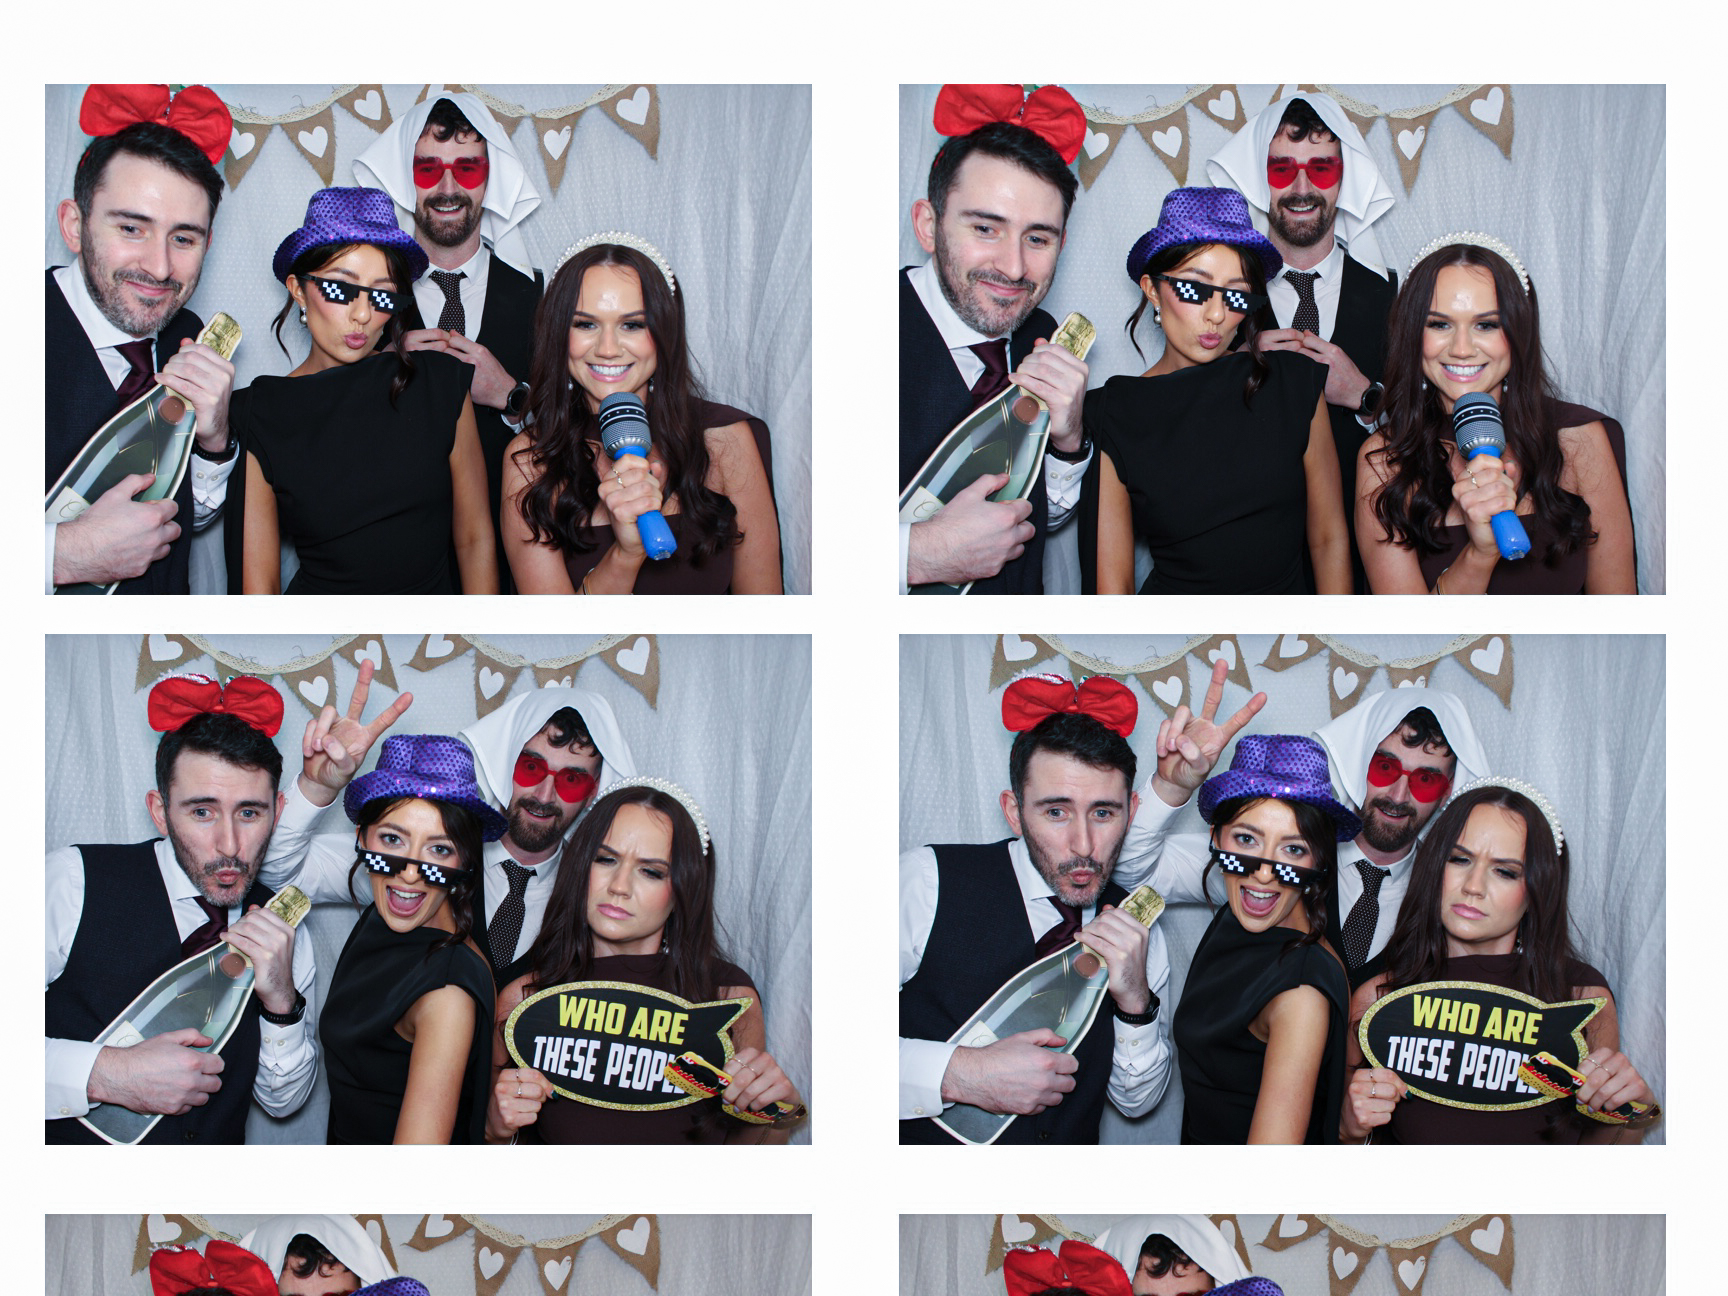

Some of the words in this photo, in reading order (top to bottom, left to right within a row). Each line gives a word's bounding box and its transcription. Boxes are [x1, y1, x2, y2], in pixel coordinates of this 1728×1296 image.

[559, 994, 627, 1035] WHO
[628, 1006, 689, 1045] ARE
[1413, 994, 1481, 1035] WHO
[1482, 1006, 1543, 1045] ARE
[532, 1036, 601, 1082] THESE
[603, 1042, 685, 1094] PEOPL
[1386, 1036, 1455, 1082] THESE
[1457, 1042, 1539, 1094] PEOPL
